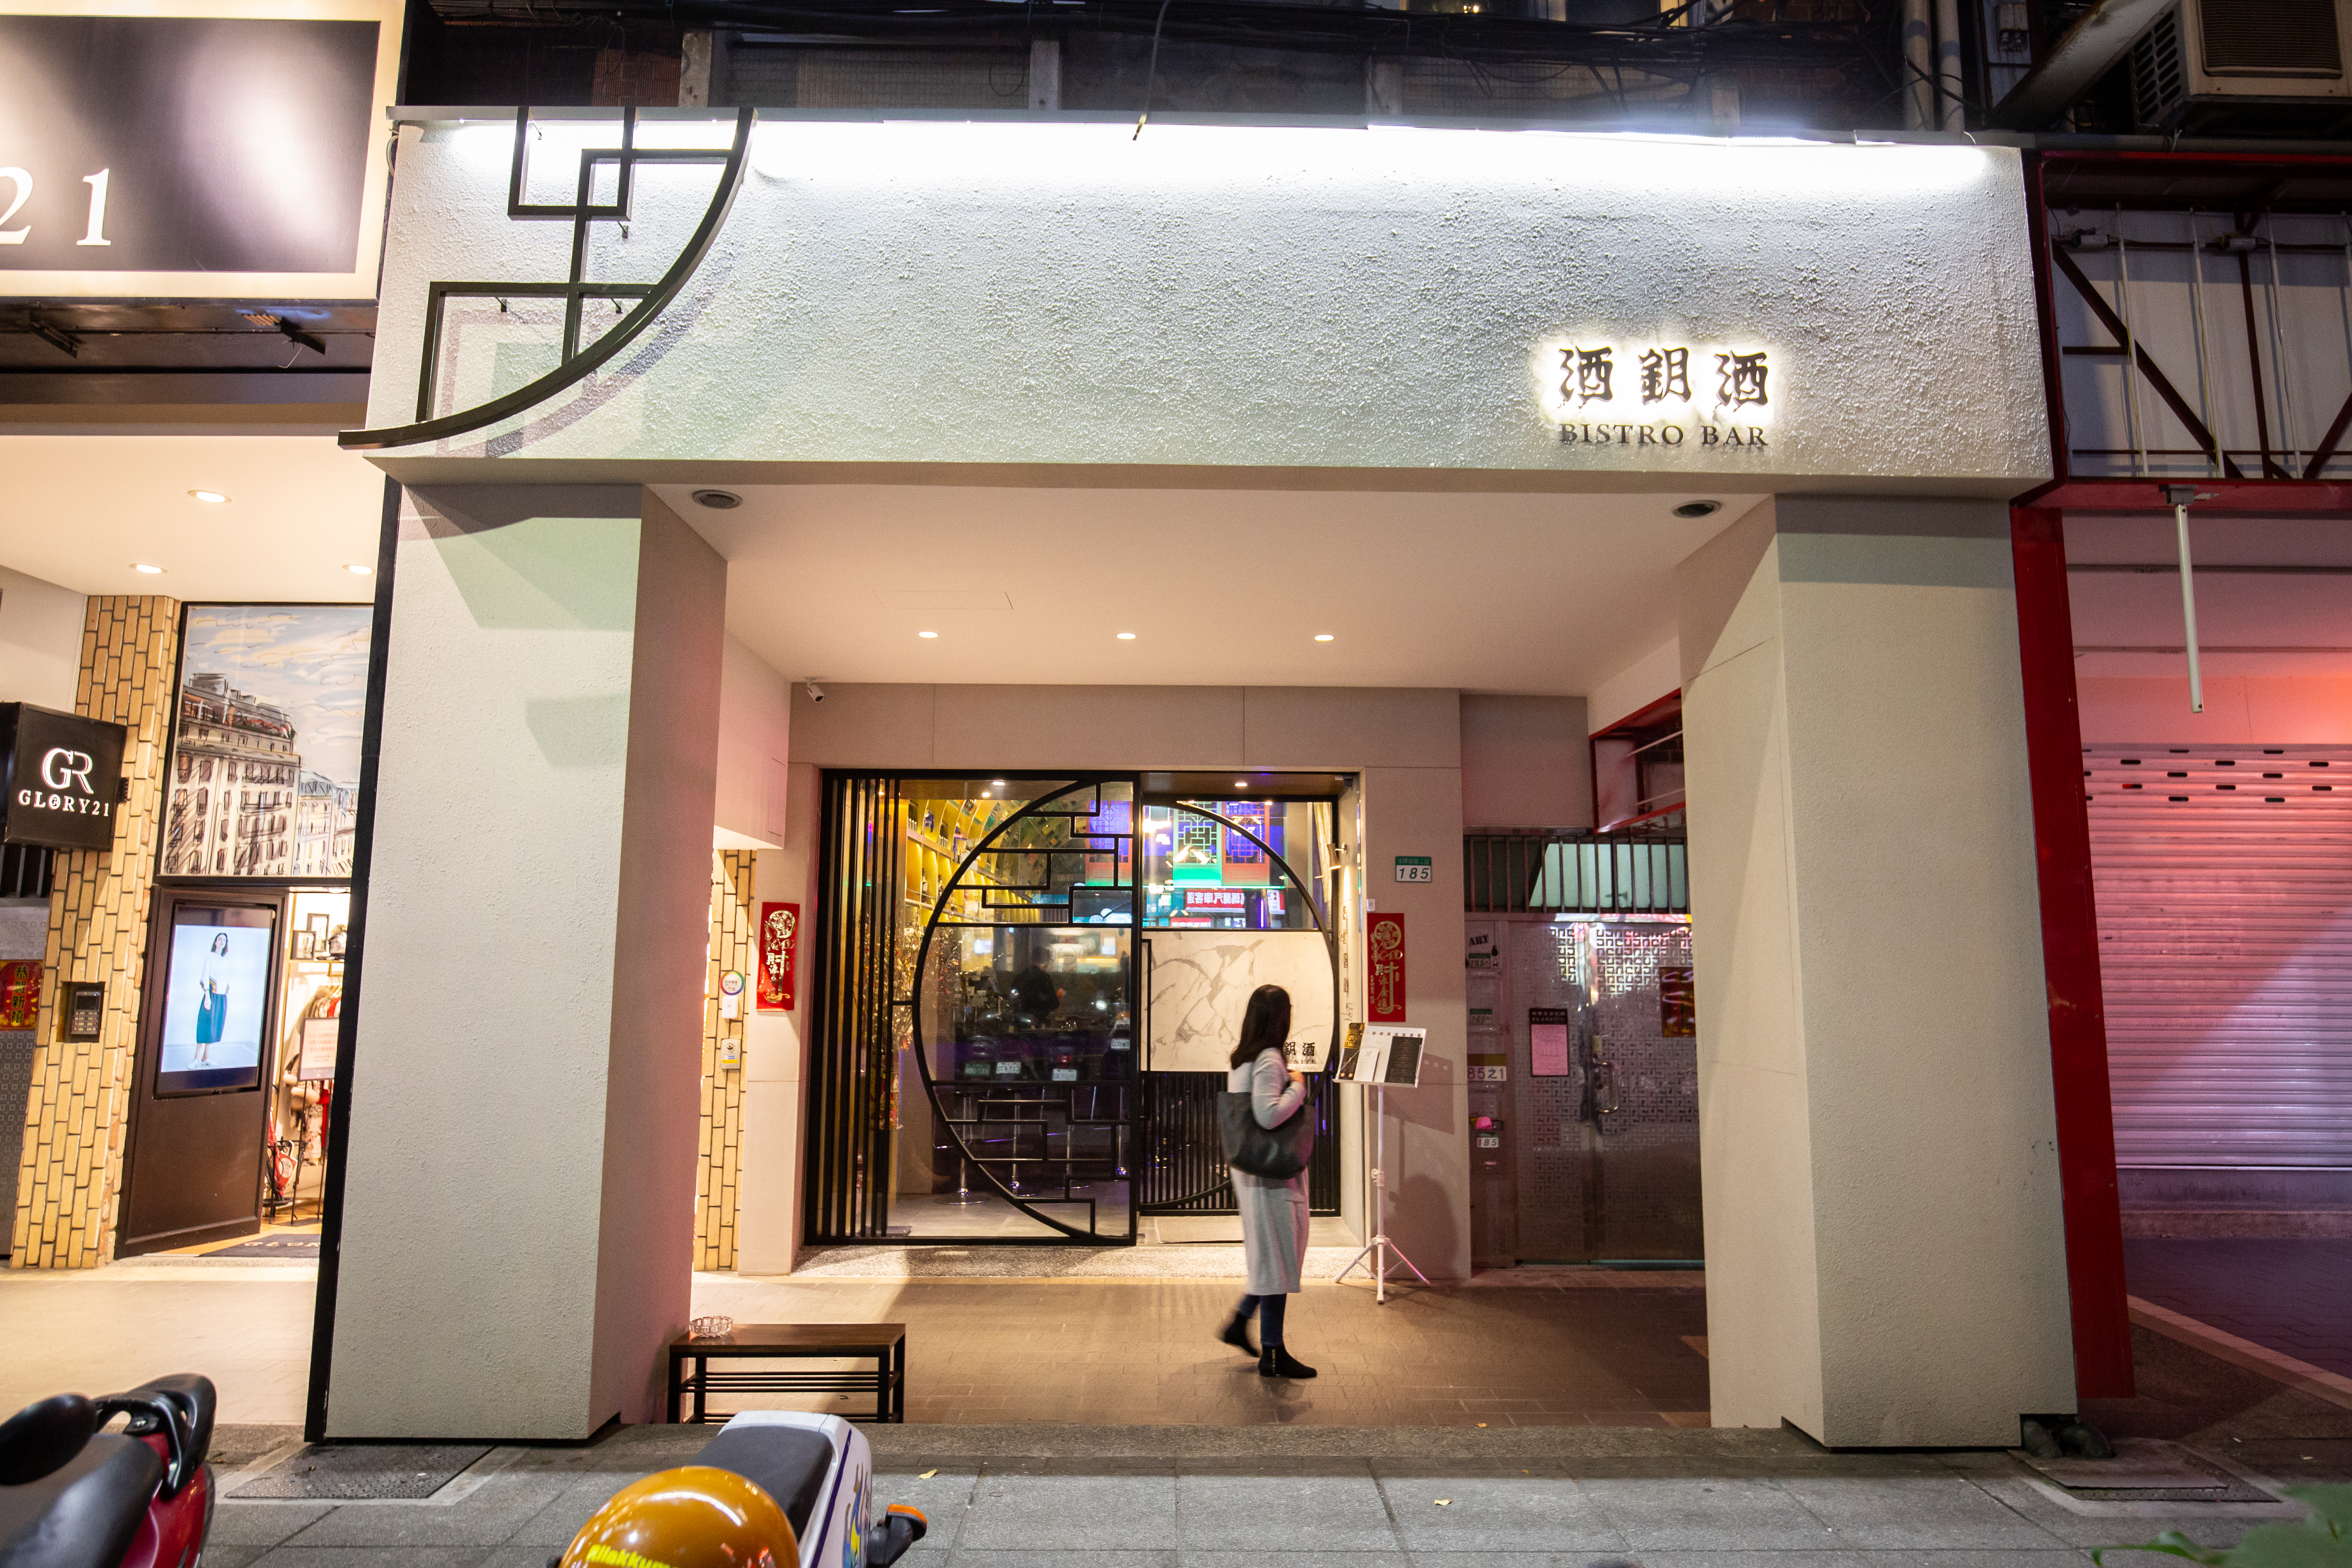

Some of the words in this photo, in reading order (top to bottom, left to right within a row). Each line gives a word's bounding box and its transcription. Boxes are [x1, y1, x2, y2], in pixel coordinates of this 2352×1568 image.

[0, 167, 111, 246] 21
[1559, 423, 1684, 445] BISTRO
[1701, 425, 1769, 446] BAR
[42, 748, 94, 794] GR
[18, 789, 109, 817] GLORY21
[1399, 868, 1429, 880] 185
[1469, 935, 1488, 947] ART
[11, 966, 29, 1023] 恭賀新禧
[1477, 1138, 1497, 1147] 185
[585, 1544, 681, 1568] Rilakkum
